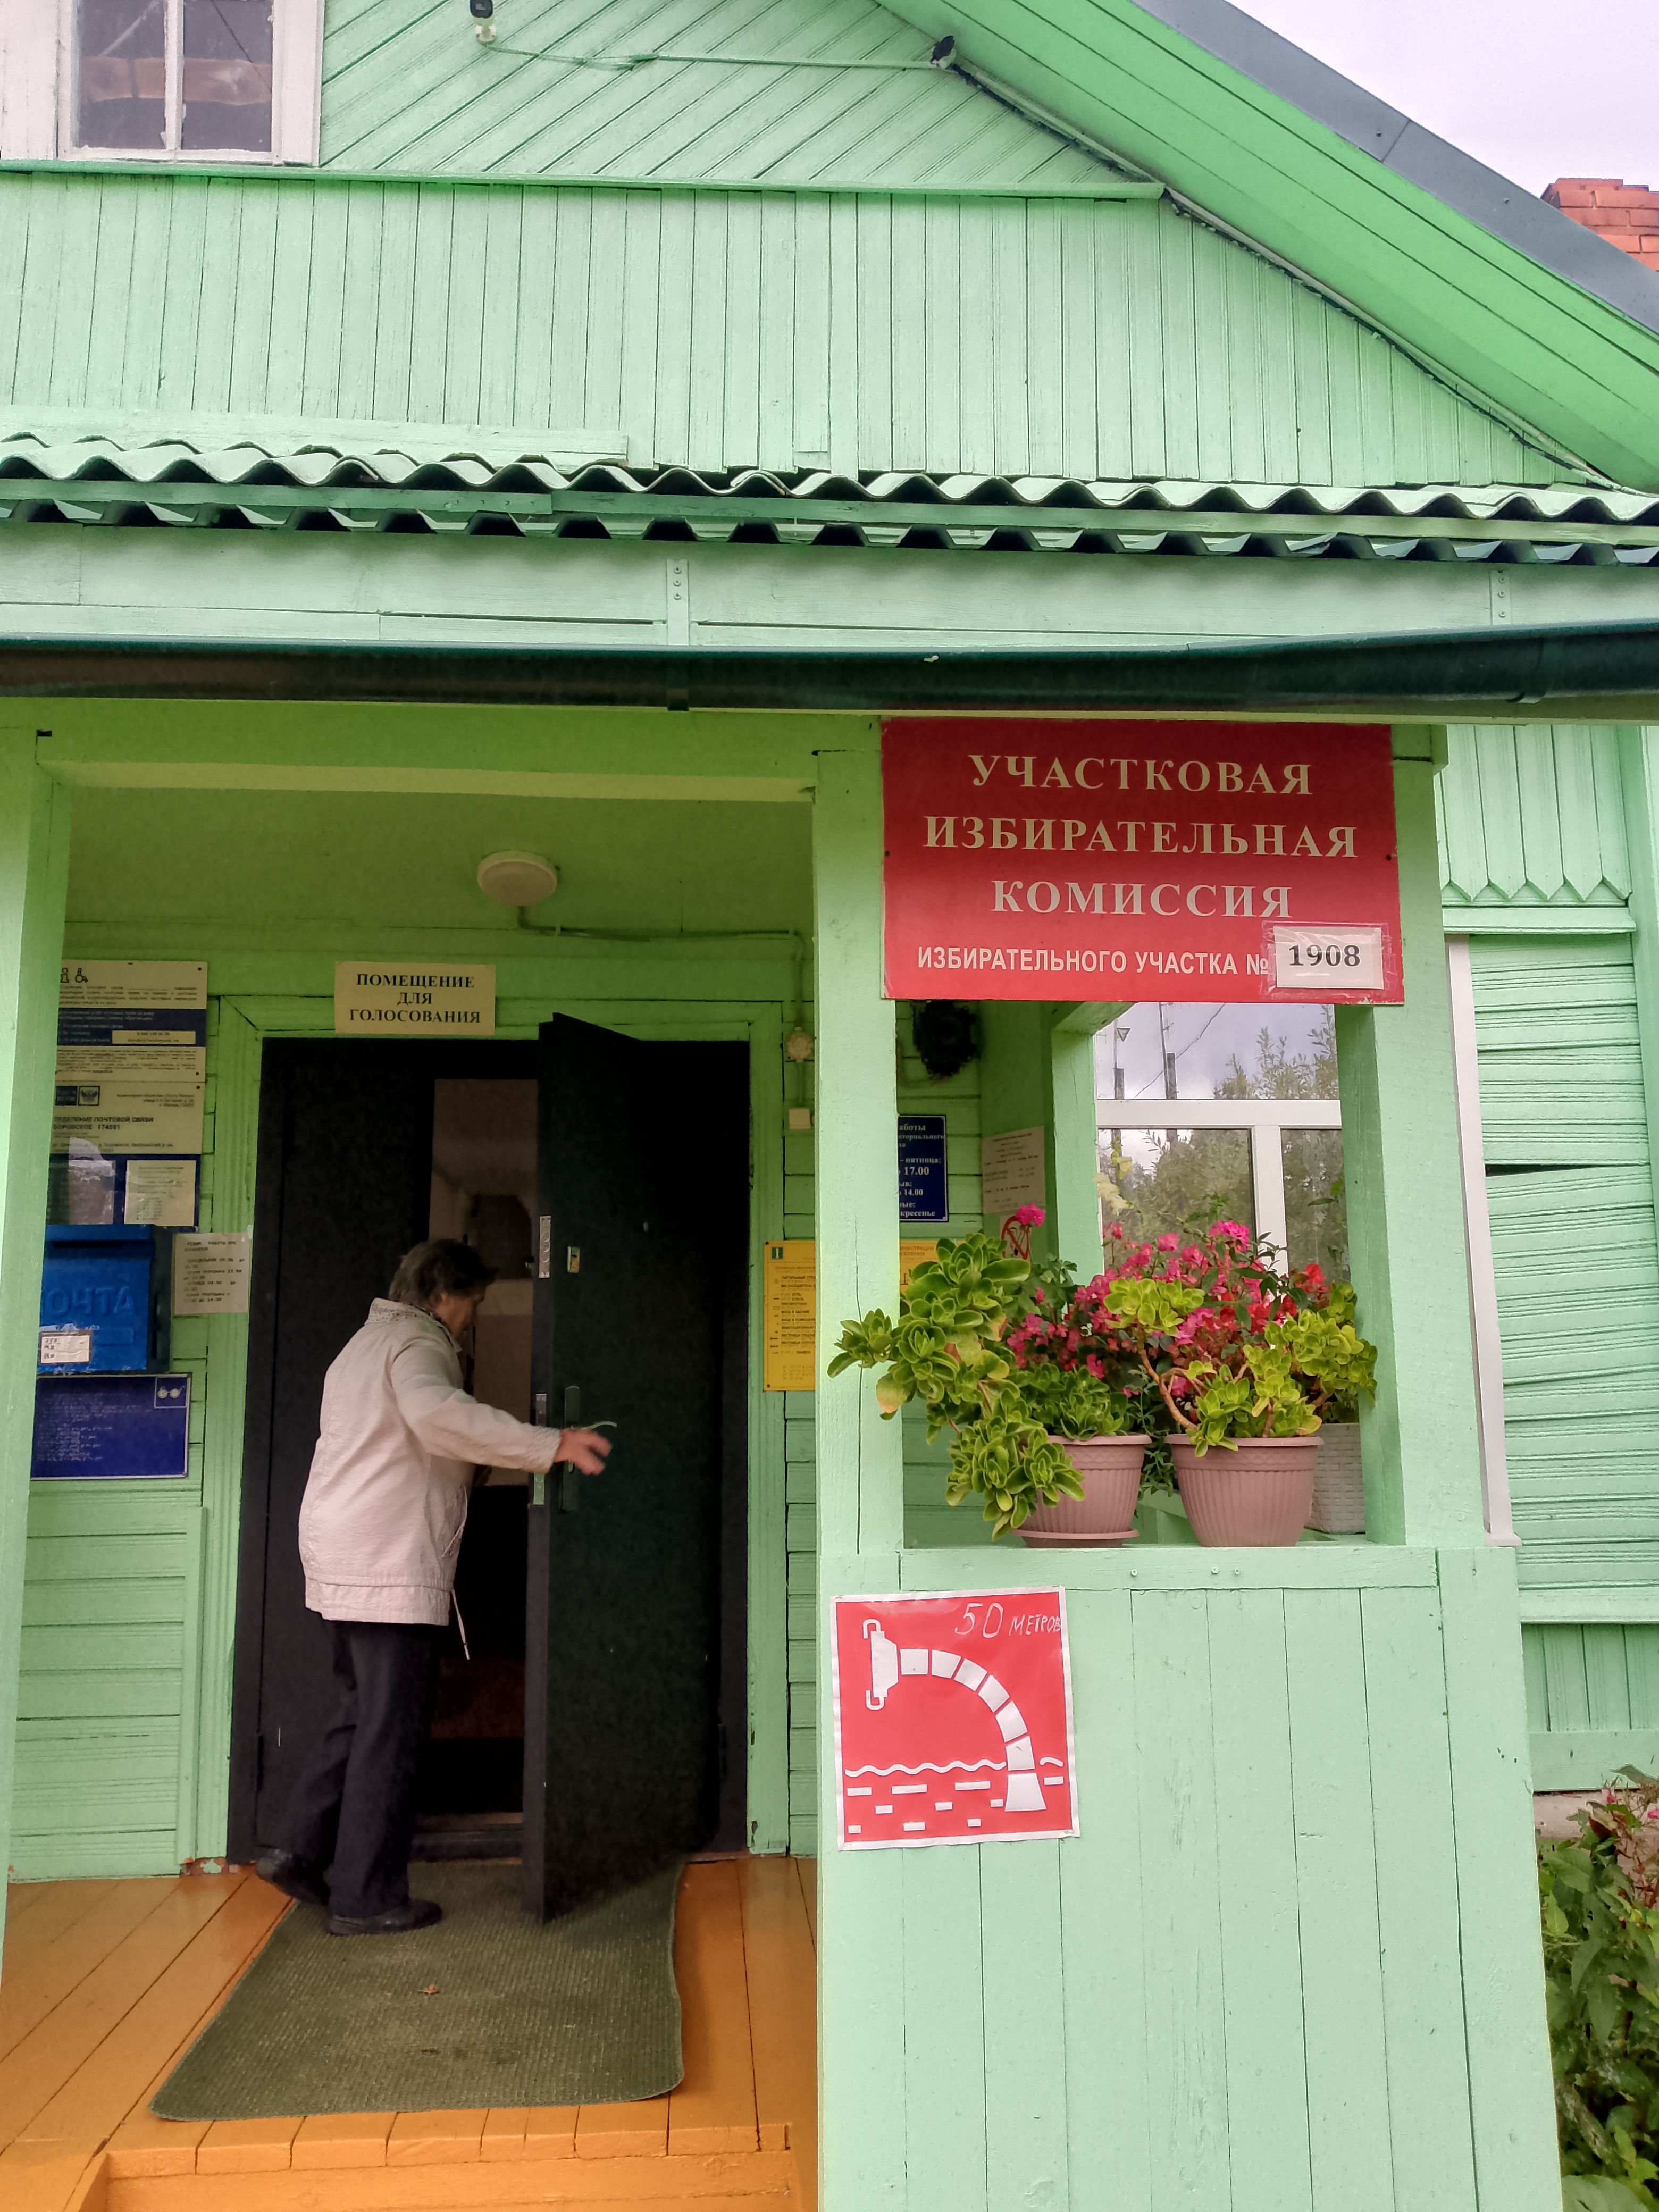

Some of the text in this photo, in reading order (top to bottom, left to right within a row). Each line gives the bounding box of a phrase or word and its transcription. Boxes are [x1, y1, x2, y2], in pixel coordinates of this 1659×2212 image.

[967, 755, 1313, 795] УЧАСТКОВАЯ
[923, 815, 1358, 858] ИЗБИРАТЕЛЬНАЯ
[991, 879, 1292, 918] КОМИССИЯ
[917, 944, 1361, 975] ИЗБИРАТЕЛЬНОГО УЧАСТКА № 1908
[356, 974, 475, 988] ПОМЕЩЕНИЕ
[397, 992, 433, 1006] ДЛЯ
[349, 1009, 481, 1023] ГОЛОСОВАНИЯ
[904, 1166, 929, 1175] 17.00
[45, 1287, 138, 1316] ОЧТА
[954, 1602, 1062, 1639] 50 МЕТРОВ
